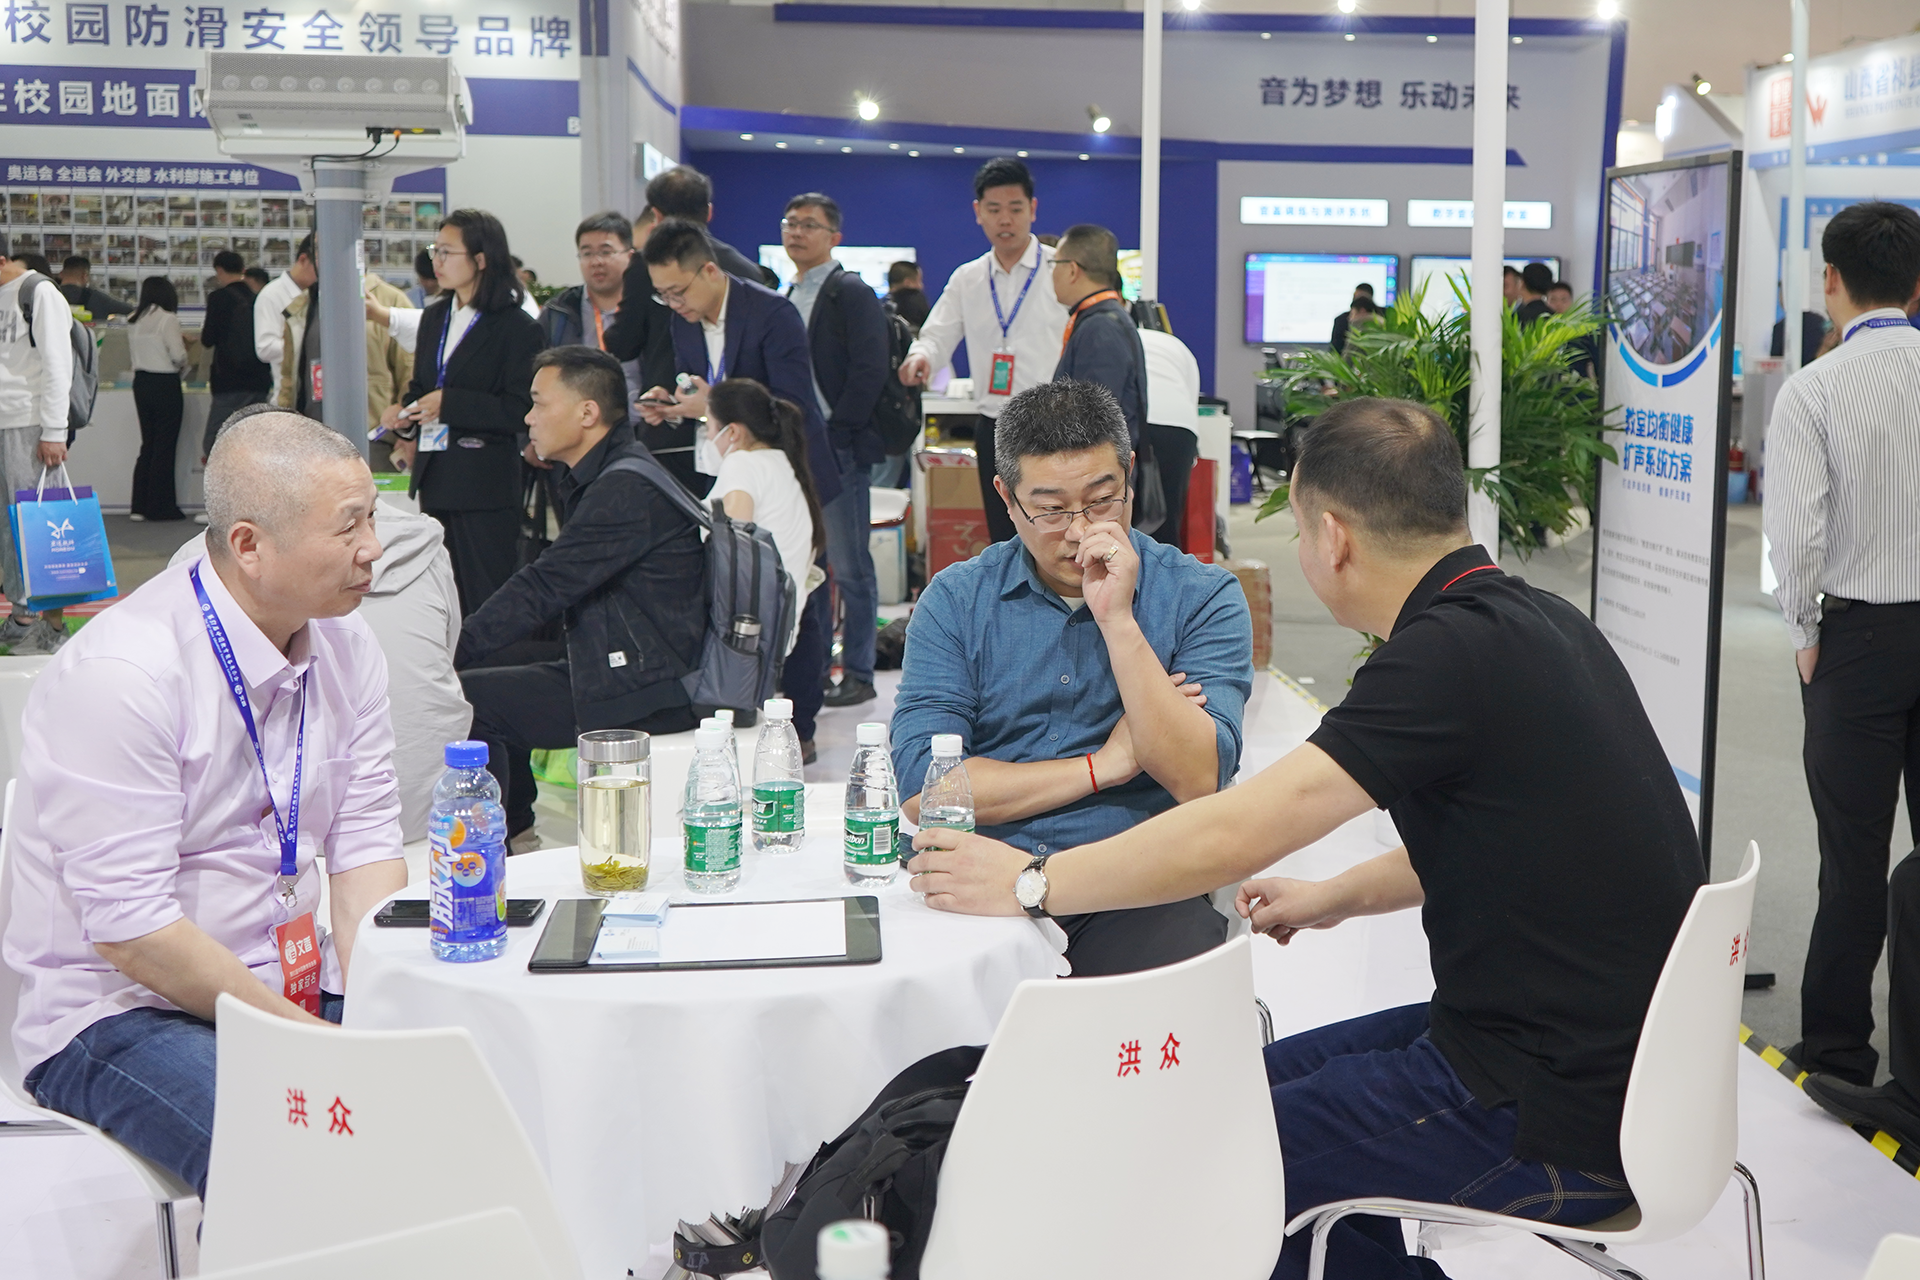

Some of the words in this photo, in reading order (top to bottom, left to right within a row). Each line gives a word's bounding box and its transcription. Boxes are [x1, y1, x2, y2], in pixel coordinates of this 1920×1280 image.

[4, 0, 571, 58] 校园防滑安全领导品牌
[1260, 77, 1383, 108] 音为梦想
[7, 164, 53, 181] 奥运会
[57, 165, 102, 182] 全运会
[105, 166, 151, 183] 外交部
[154, 168, 260, 186] 水利部施工单位
[1625, 407, 1694, 445] 教室均衡健康
[1623, 442, 1693, 484] 扩声系统方案
